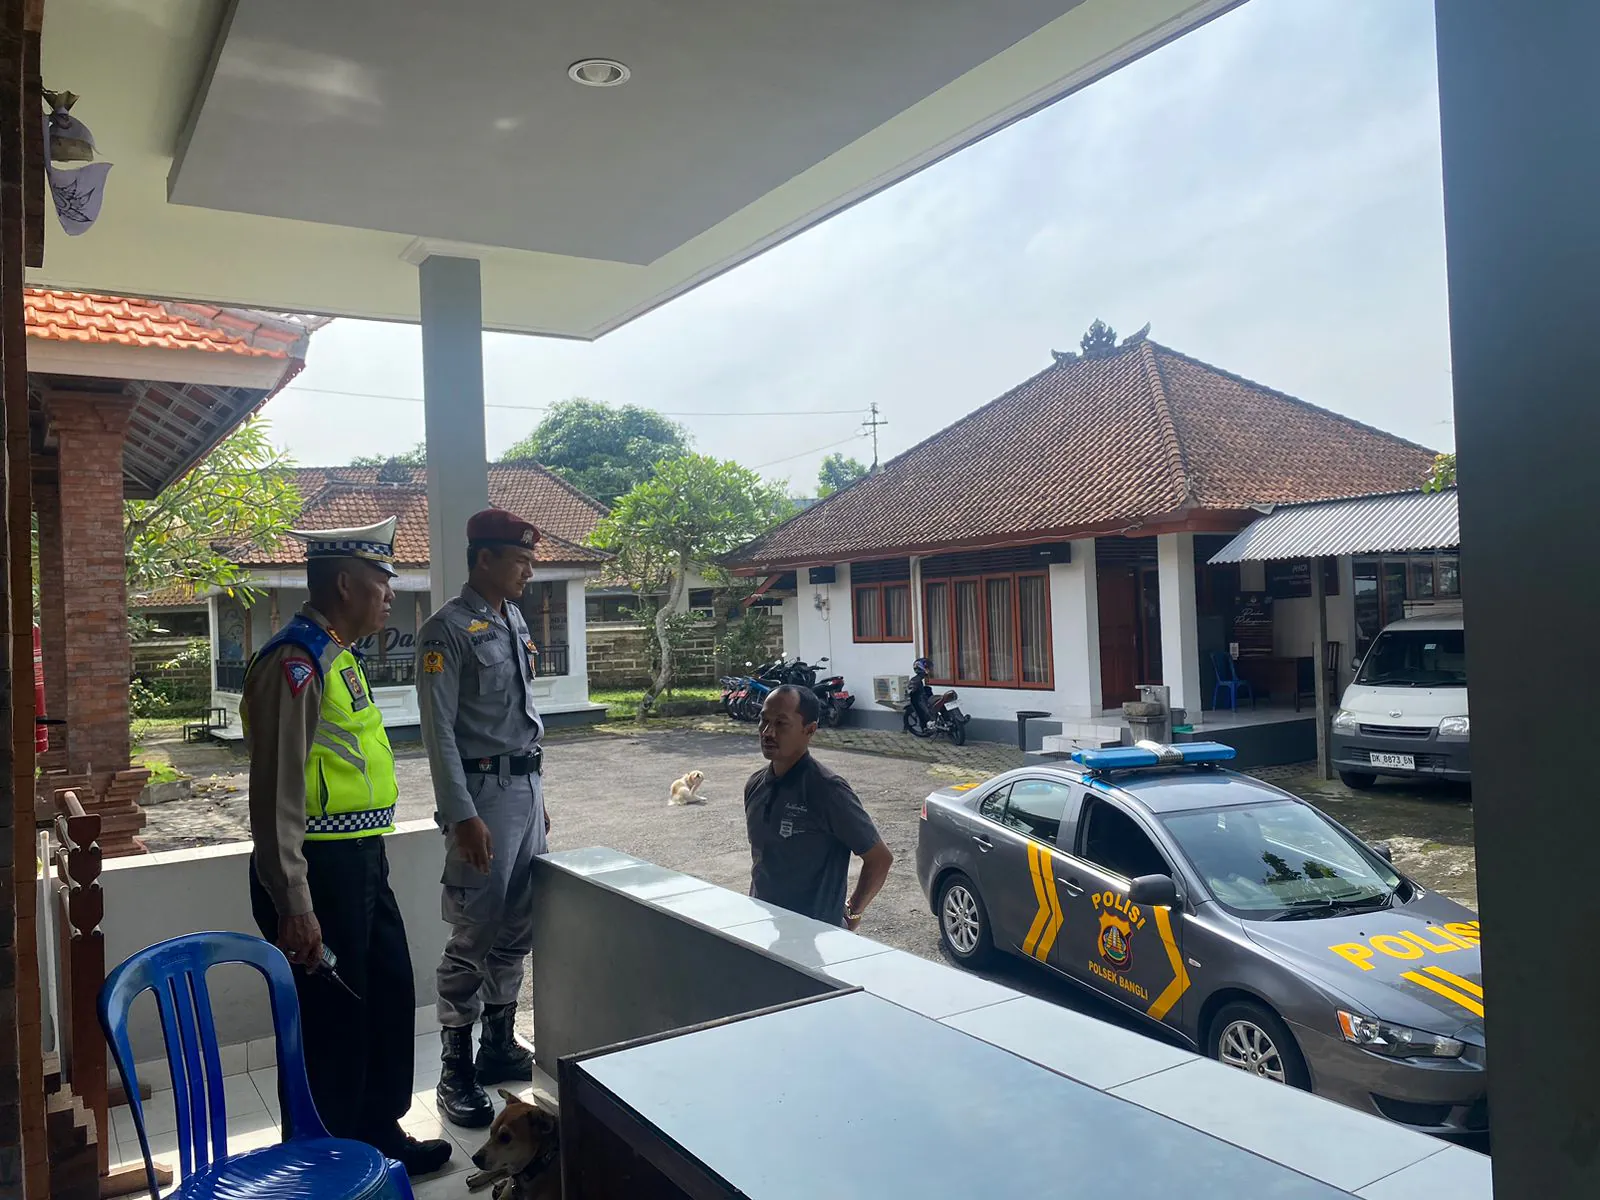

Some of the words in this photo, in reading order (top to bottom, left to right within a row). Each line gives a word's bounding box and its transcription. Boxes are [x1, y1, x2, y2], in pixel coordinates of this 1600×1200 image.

[1371, 754, 1381, 762] DK
[1383, 755, 1401, 764] 8873
[1403, 756, 1413, 765] BN
[1091, 890, 1146, 930] POLISI
[1328, 920, 1480, 972] POLIS
[1088, 960, 1117, 984] POLSEK
[1119, 975, 1149, 1001] BANGLI
